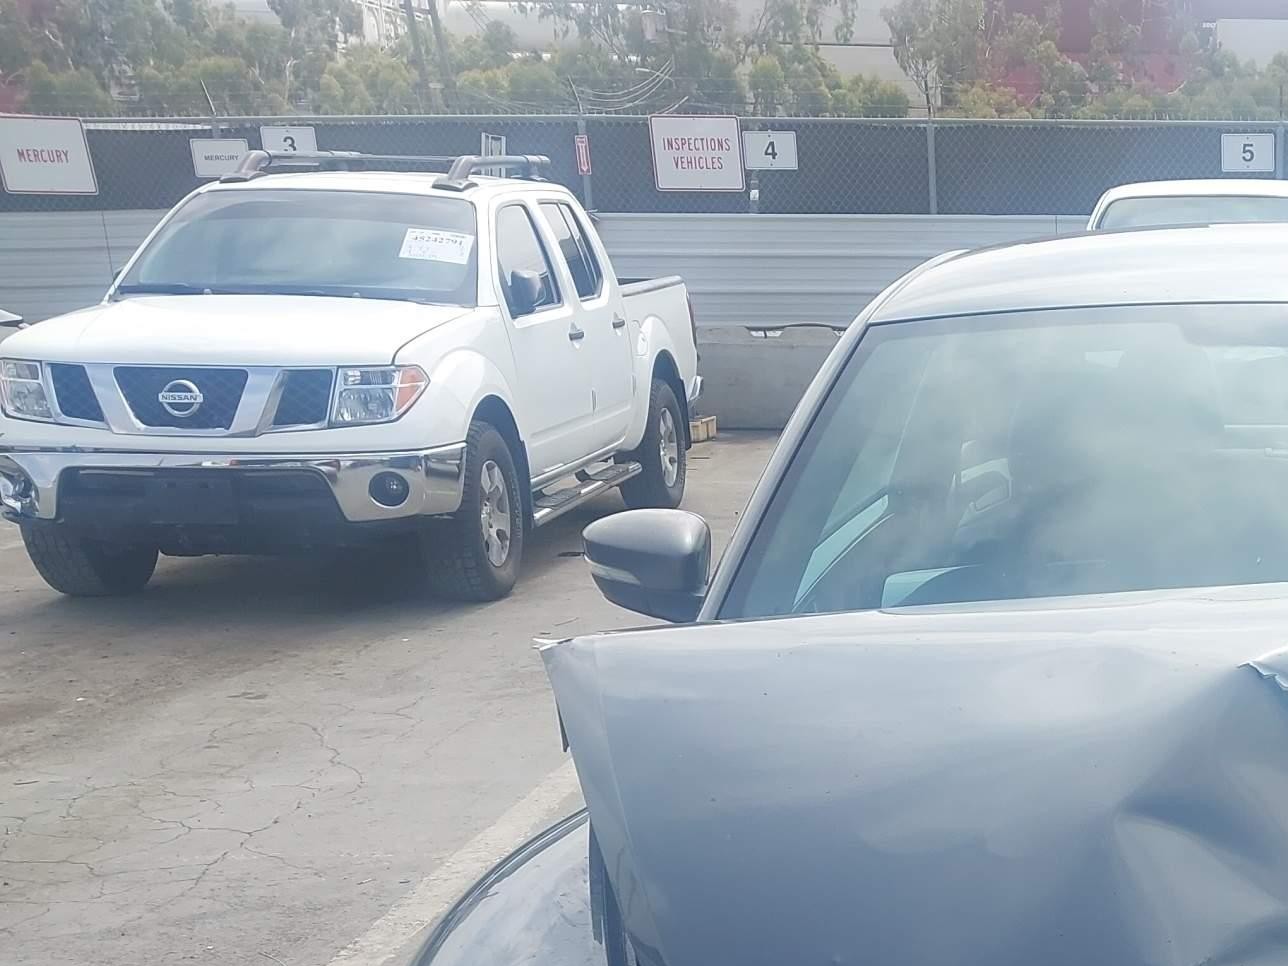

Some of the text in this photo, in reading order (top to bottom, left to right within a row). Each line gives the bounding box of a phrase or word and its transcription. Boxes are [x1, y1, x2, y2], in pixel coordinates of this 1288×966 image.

[282, 136, 297, 151] 3
[662, 137, 731, 151] INSPECTIONS
[764, 140, 778, 160] 4
[16, 148, 69, 163] MERCURY
[1241, 143, 1255, 162] 5
[673, 156, 723, 170] VEHICLES
